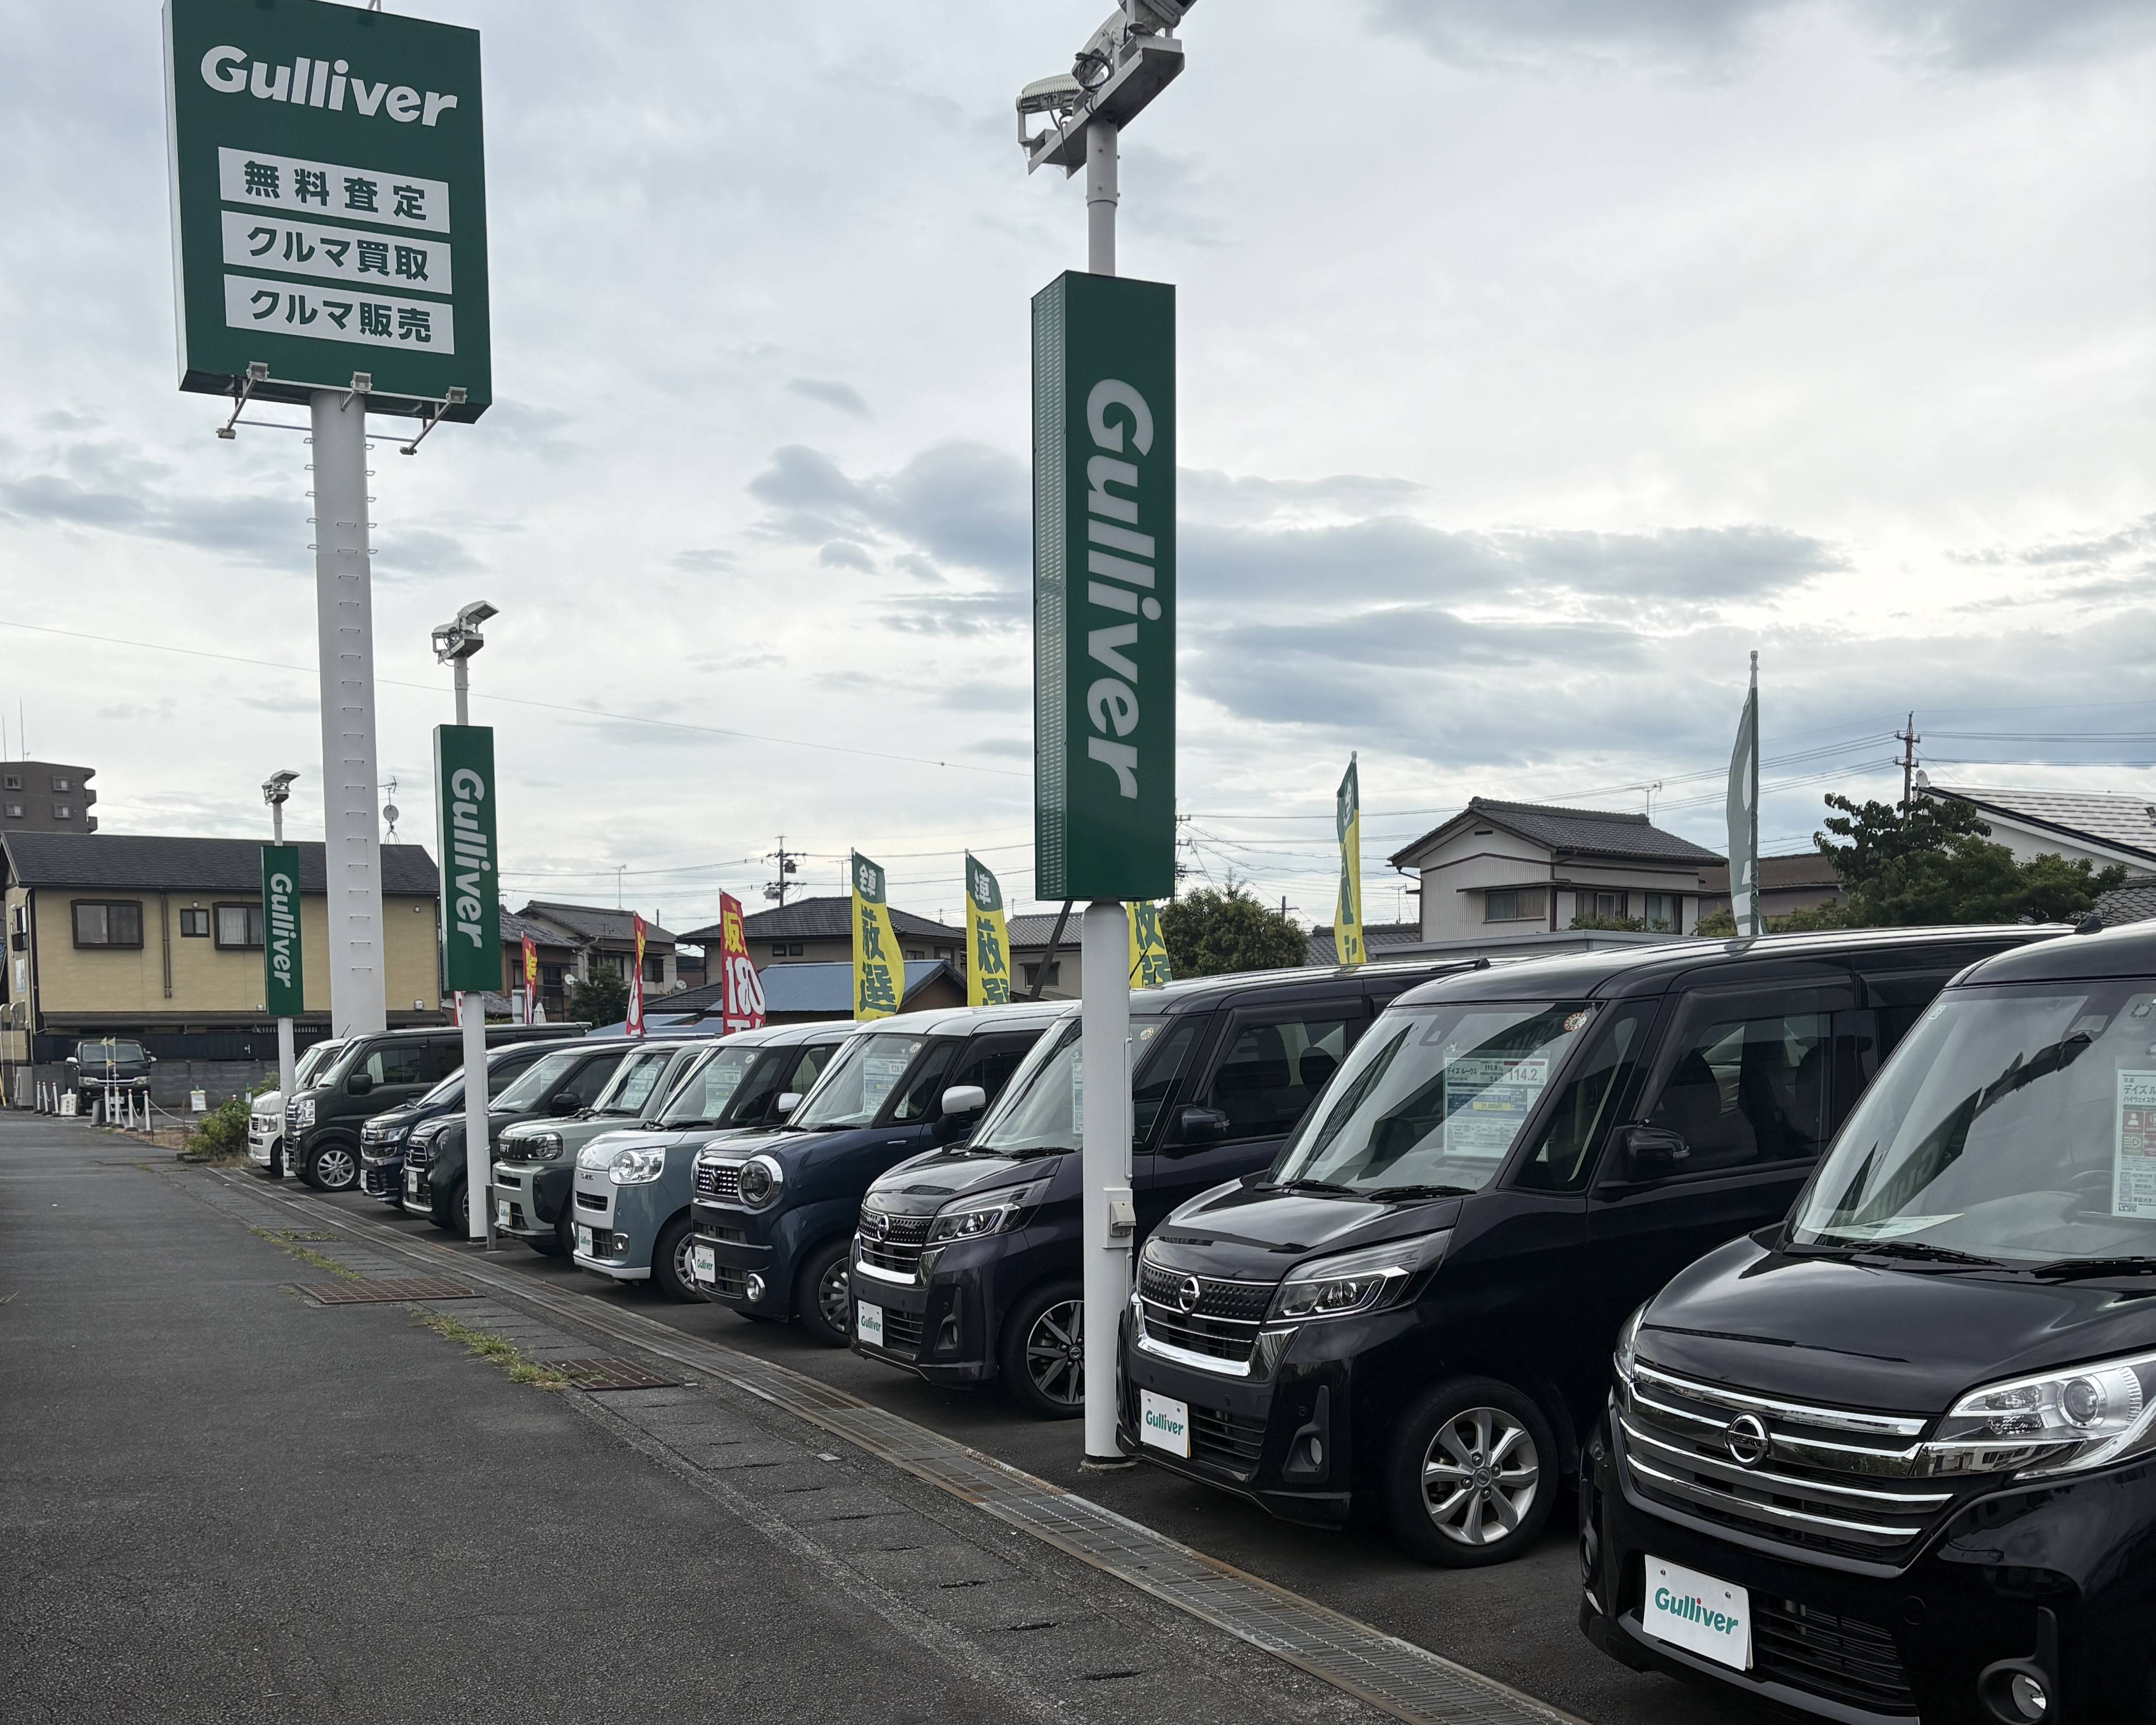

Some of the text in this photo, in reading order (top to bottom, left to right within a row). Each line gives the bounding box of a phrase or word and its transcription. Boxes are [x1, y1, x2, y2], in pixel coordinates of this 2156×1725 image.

[201, 46, 457, 127] Gulliver
[244, 161, 426, 220] 無料査定
[247, 226, 429, 281] クルマ買取
[250, 290, 431, 343] クルマ販売
[1087, 378, 1162, 799] Gulliver
[452, 768, 491, 948] Gulliver
[270, 873, 297, 988] Gulliver
[725, 956, 766, 1016] 180
[1510, 1068, 1538, 1081] 114.2
[861, 1315, 881, 1332] Gulliver
[1146, 1410, 1184, 1436] Gulliver
[1655, 1587, 1739, 1635] Gulliver
